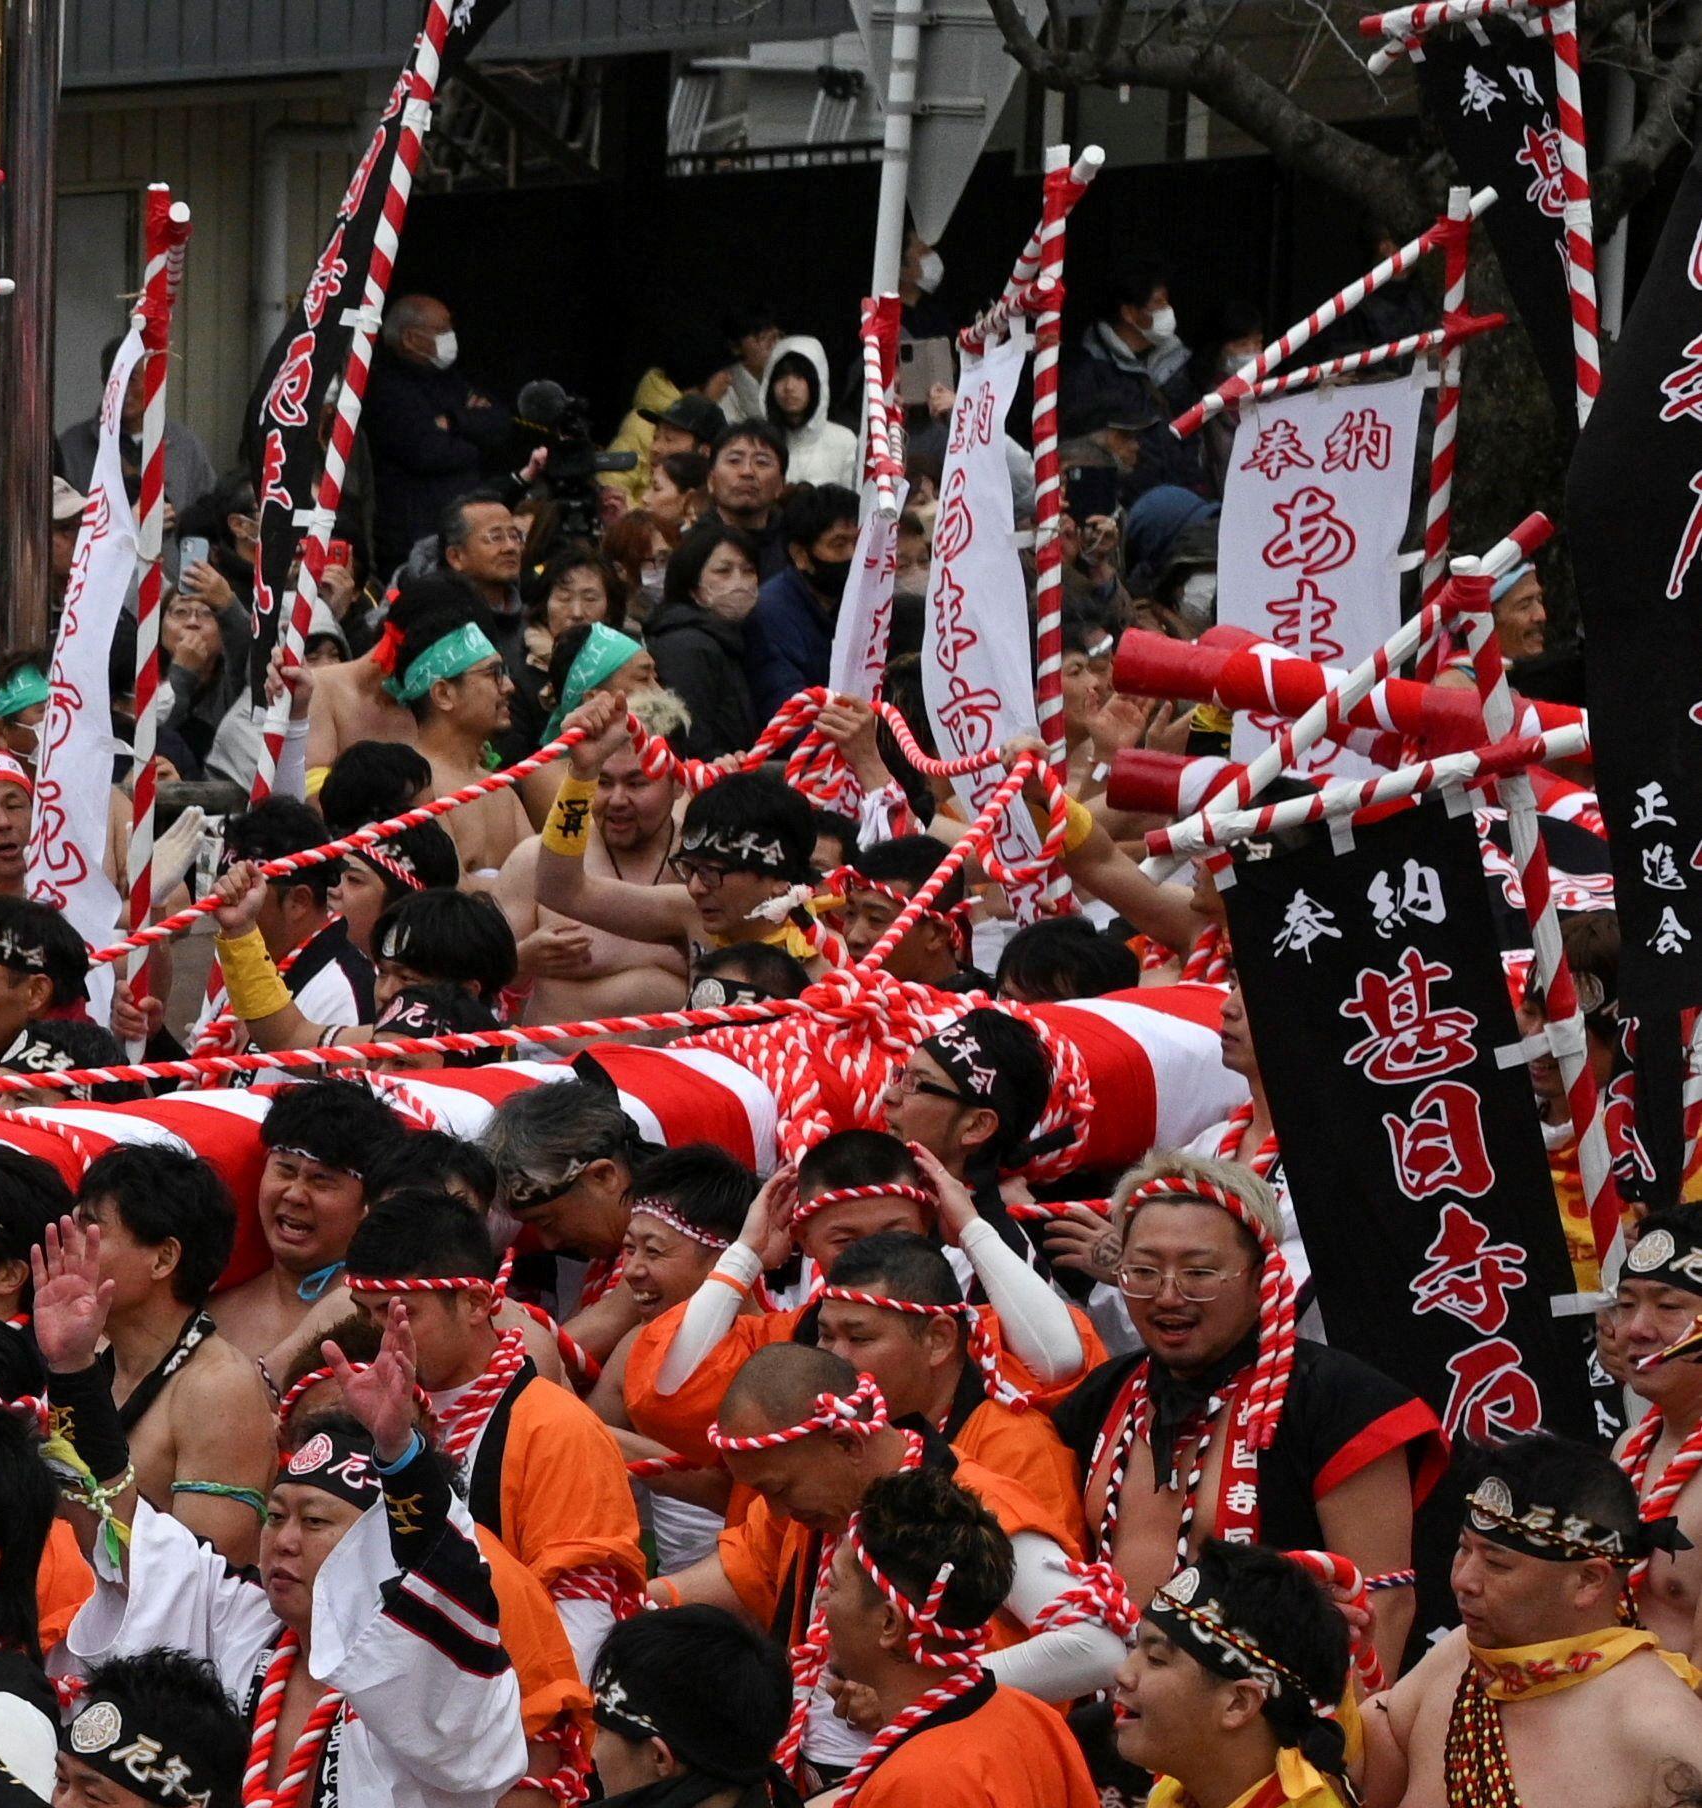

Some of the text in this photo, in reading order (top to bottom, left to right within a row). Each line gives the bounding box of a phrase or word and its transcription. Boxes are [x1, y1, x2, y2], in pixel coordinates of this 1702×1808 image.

[1241, 409, 1392, 480] 奉納
[1271, 858, 1446, 964] 奉納
[1629, 781, 1692, 957] 正進会
